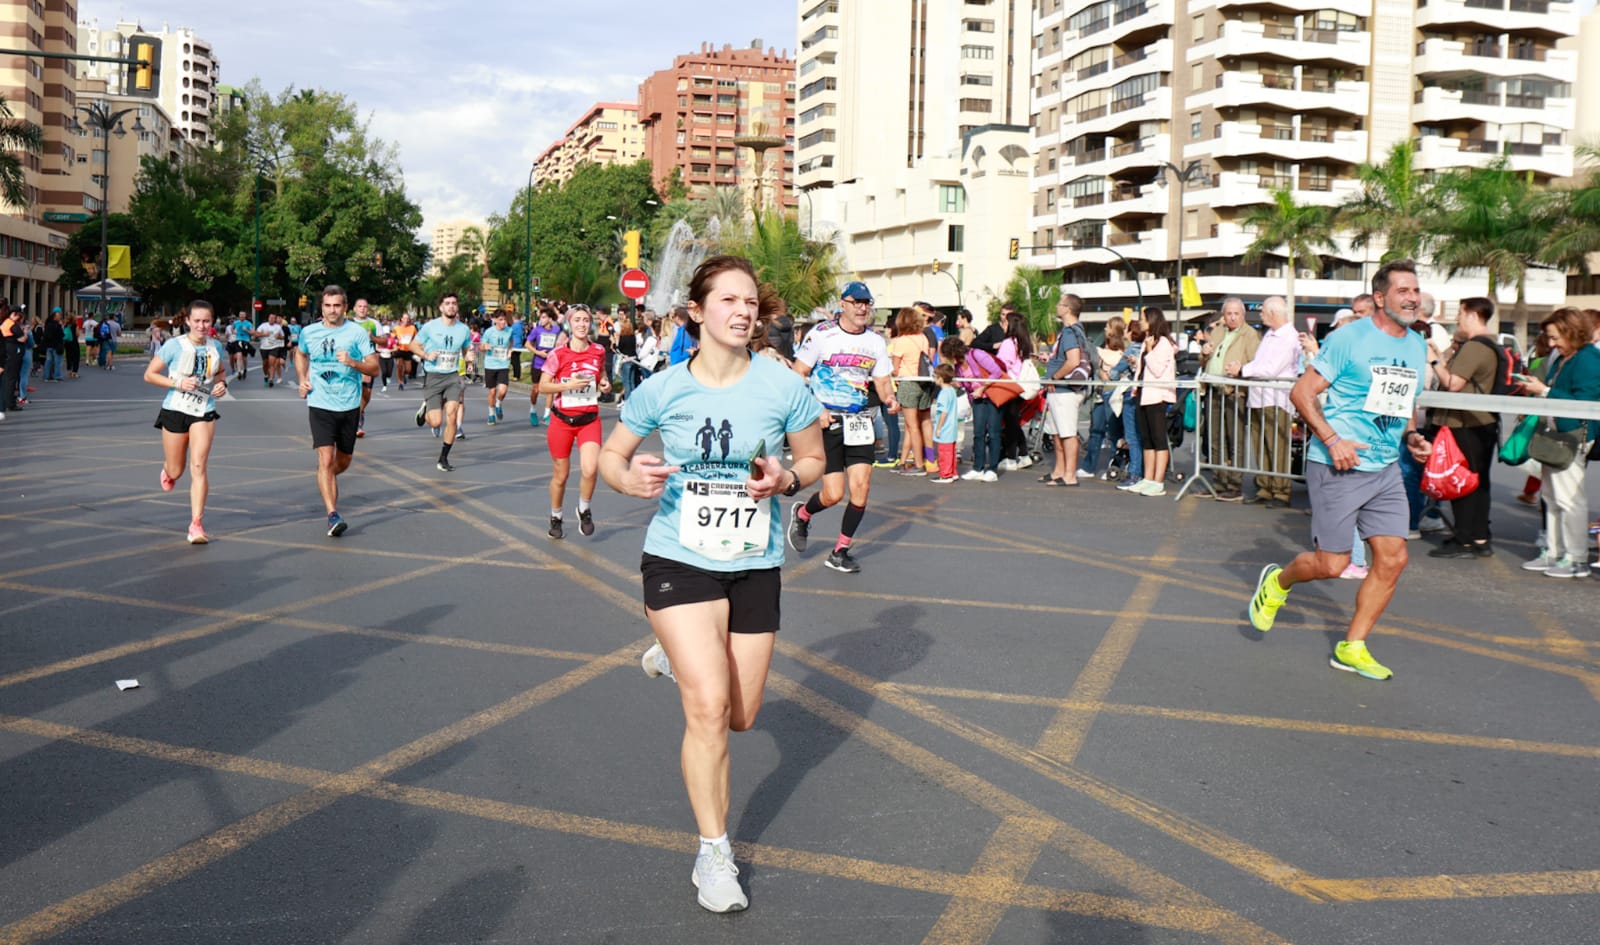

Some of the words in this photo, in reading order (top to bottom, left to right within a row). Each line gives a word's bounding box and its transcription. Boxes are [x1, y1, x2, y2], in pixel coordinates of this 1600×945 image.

[1372, 366, 1388, 375] 43
[1380, 381, 1409, 397] 1540
[182, 391, 203, 404] 1776
[849, 421, 868, 431] 9576
[689, 462, 727, 472] CARRERA
[687, 481, 709, 496] 43
[697, 506, 757, 528] 9717
